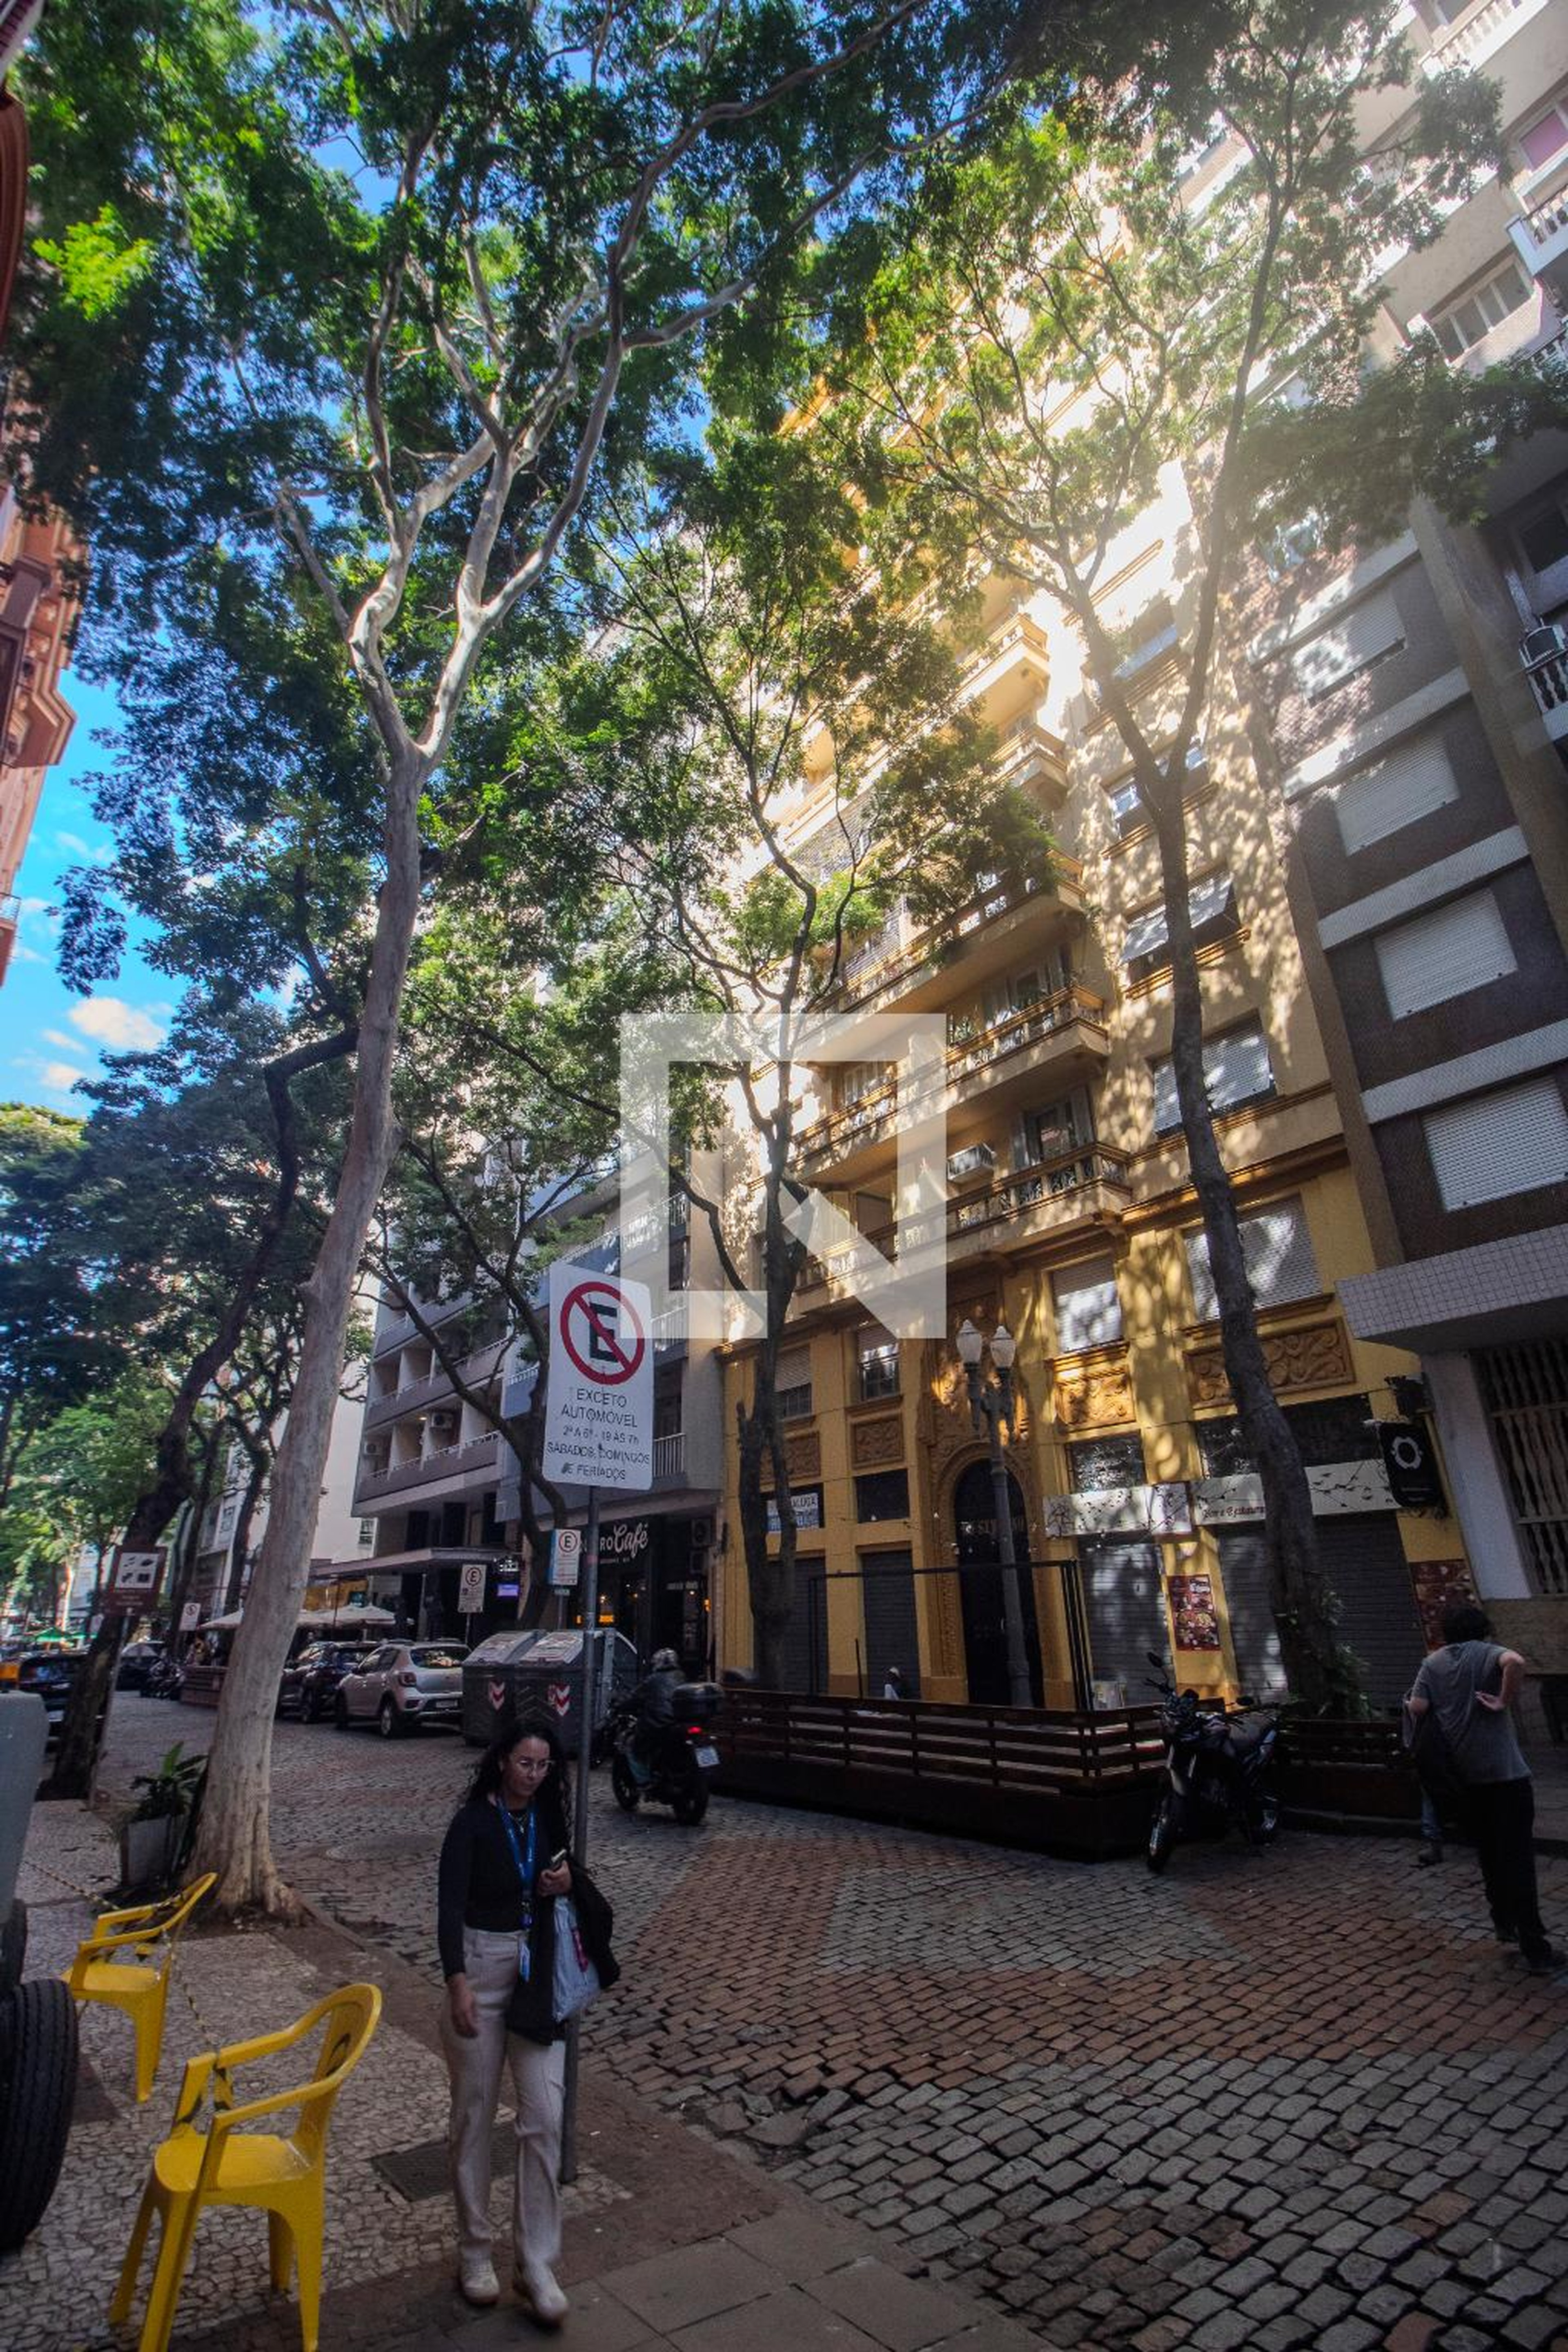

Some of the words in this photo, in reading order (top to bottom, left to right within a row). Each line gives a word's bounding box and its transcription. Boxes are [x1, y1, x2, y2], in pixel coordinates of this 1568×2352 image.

[577, 1389, 627, 1408] EXCETO
[577, 1464, 626, 1481] FERIADOS
[564, 1535, 572, 1548] E
[614, 1522, 648, 1559] Café
